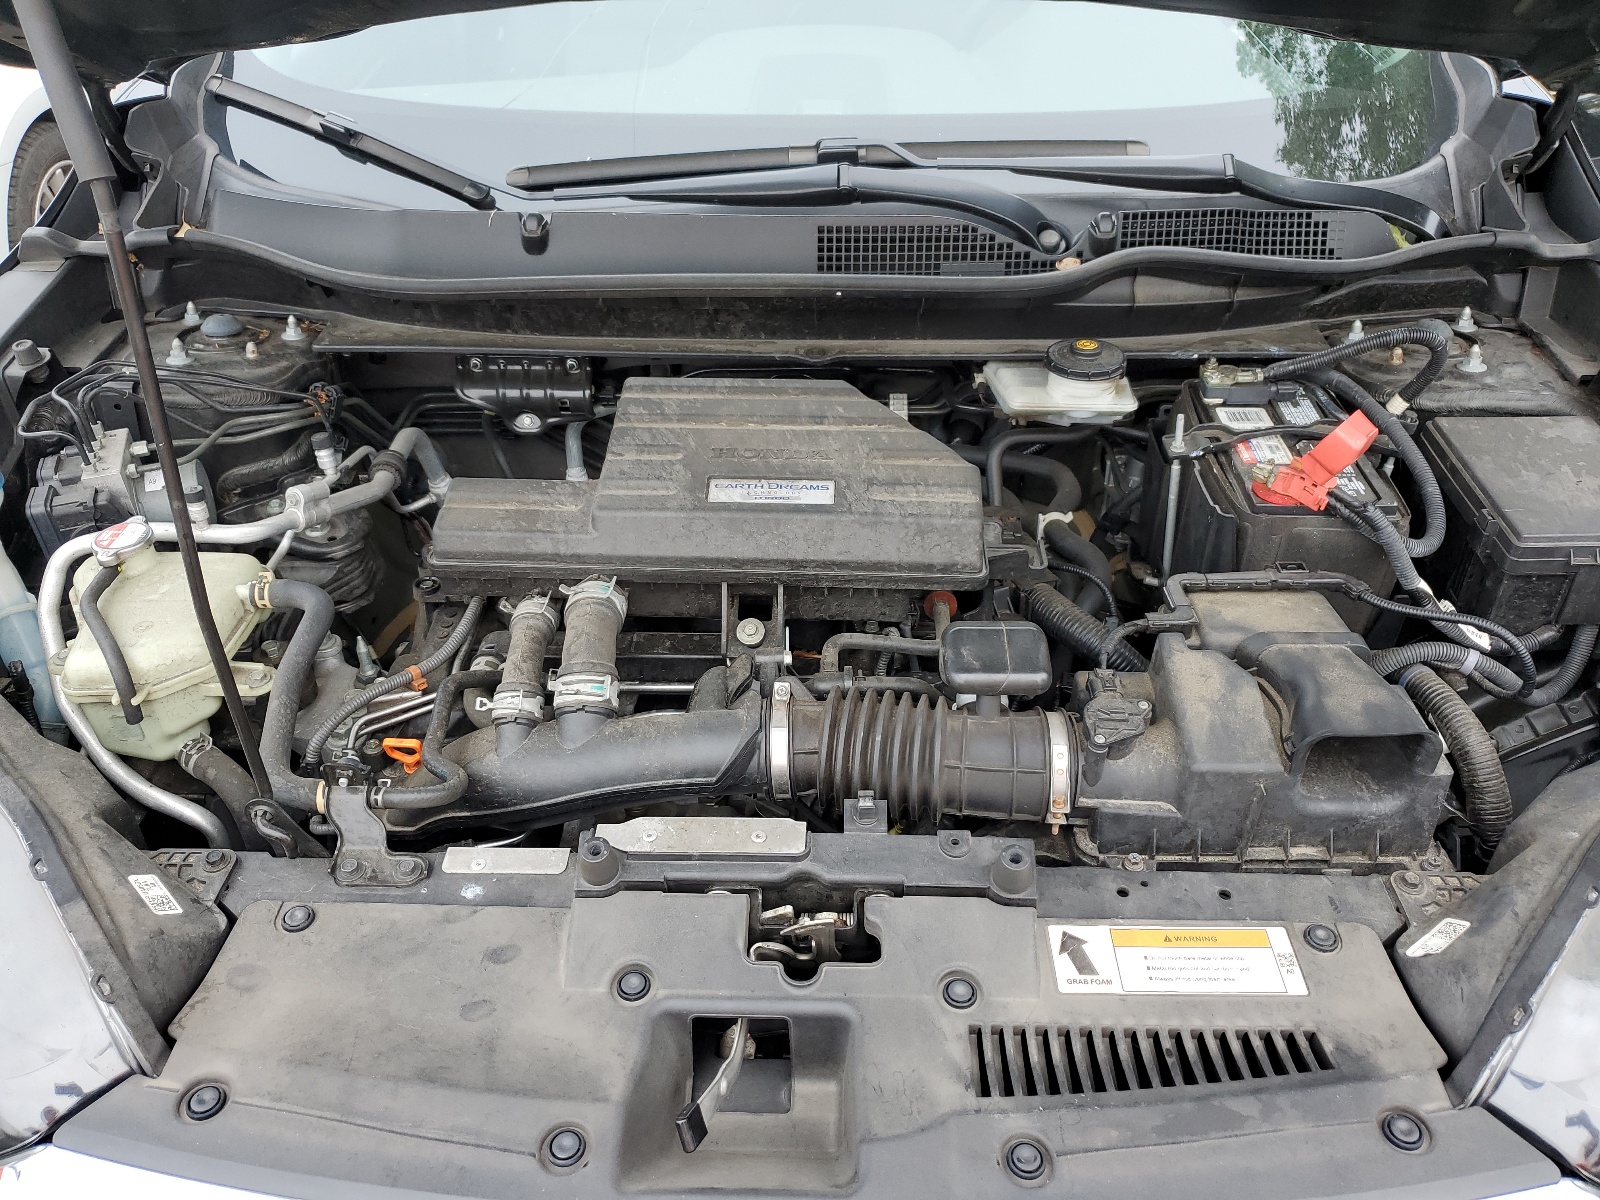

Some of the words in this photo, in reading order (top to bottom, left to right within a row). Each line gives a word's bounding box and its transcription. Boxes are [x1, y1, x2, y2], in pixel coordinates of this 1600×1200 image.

[710, 447, 834, 460] HONDA
[768, 482, 830, 491] DREAMS
[1173, 935, 1218, 943] WARNING
